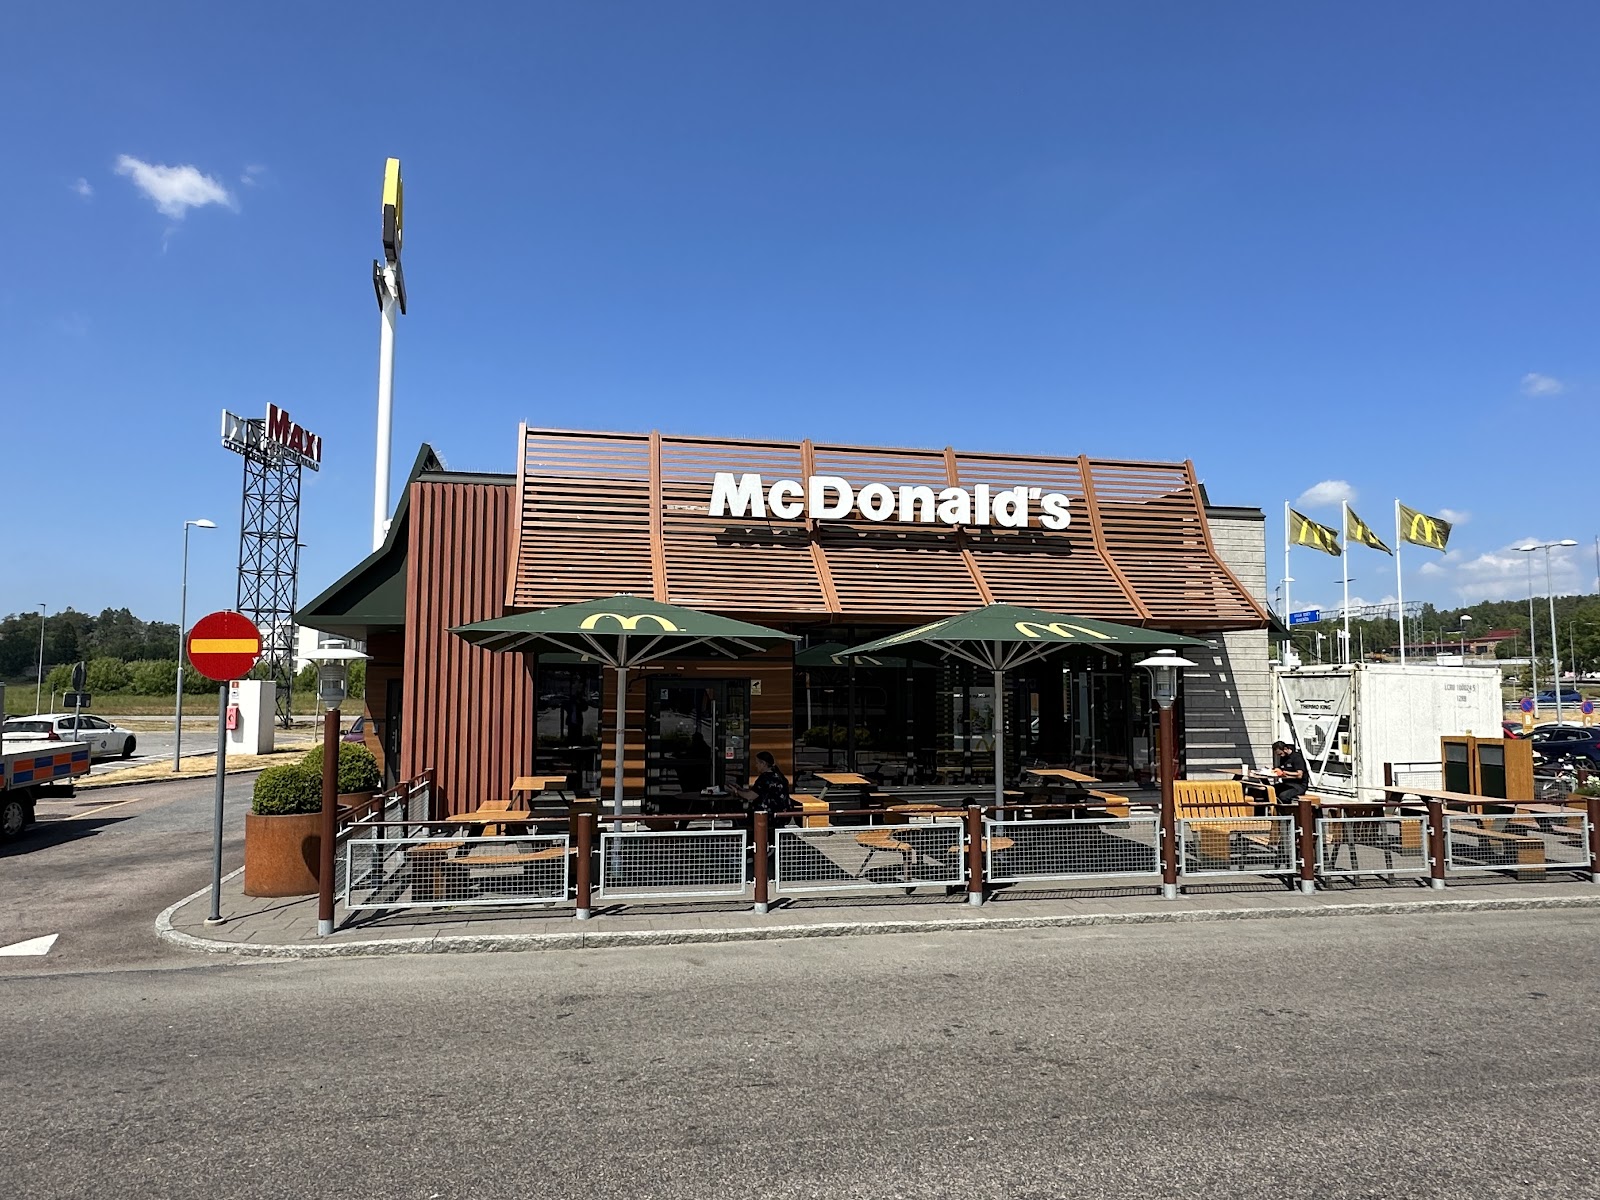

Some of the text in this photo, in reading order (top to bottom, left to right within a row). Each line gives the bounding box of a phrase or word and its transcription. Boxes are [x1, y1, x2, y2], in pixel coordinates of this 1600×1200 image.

[267, 402, 321, 463] MAXI
[708, 472, 1072, 530] McDonald's
[1525, 714, 1531, 725] B
